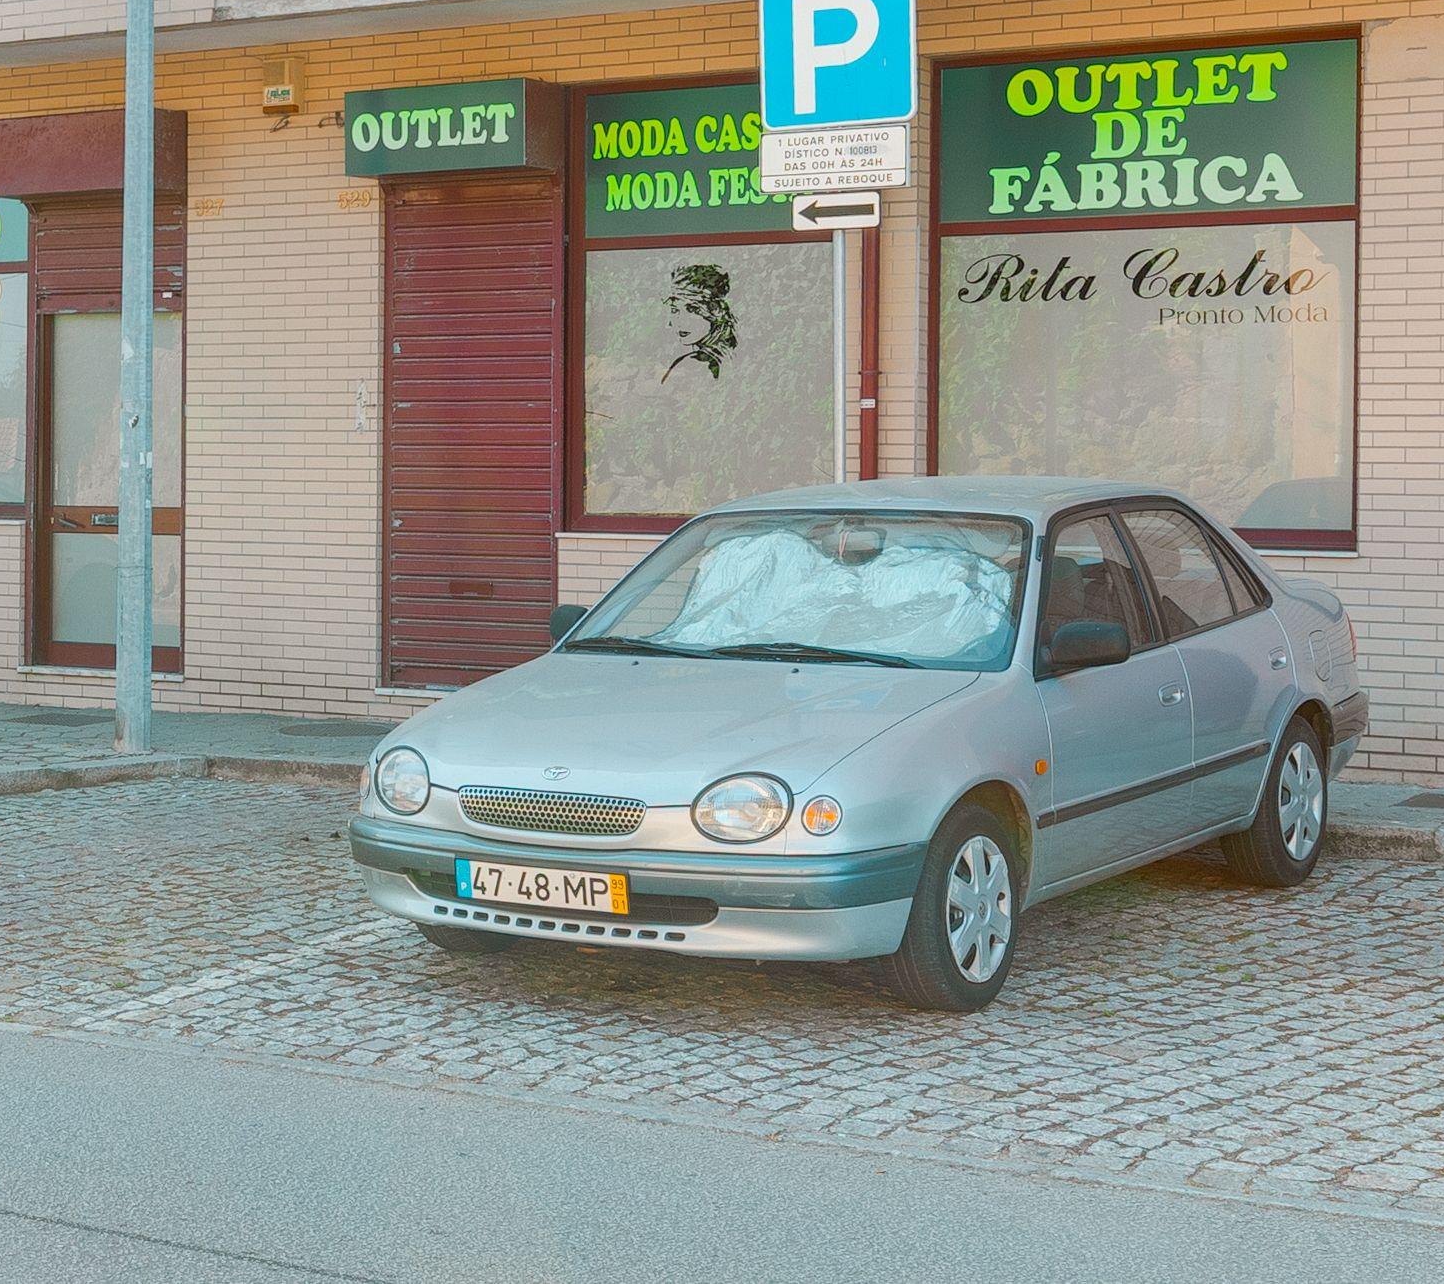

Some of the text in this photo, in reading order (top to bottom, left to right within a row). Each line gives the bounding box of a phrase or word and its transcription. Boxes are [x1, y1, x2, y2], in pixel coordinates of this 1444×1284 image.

[1006, 51, 1288, 116] OUTLET
[351, 103, 515, 152] OUTLET
[592, 117, 689, 160] MODA
[1090, 107, 1188, 159] DE
[777, 132, 889, 147] 1 LUGAR PRIVATIVO
[784, 148, 830, 159] DÍSTICO
[784, 162, 806, 172] DAS
[860, 158, 883, 167] 24H
[605, 170, 702, 212] MODA
[774, 173, 893, 188] SUJEITO A REBOQUE
[989, 152, 1304, 214] FÁBRICA
[337, 190, 372, 209] 529
[958, 247, 1330, 304] Rita Castro
[1158, 303, 1328, 326] Pronto Moda
[611, 879, 624, 890] 99
[612, 899, 626, 910] 01
